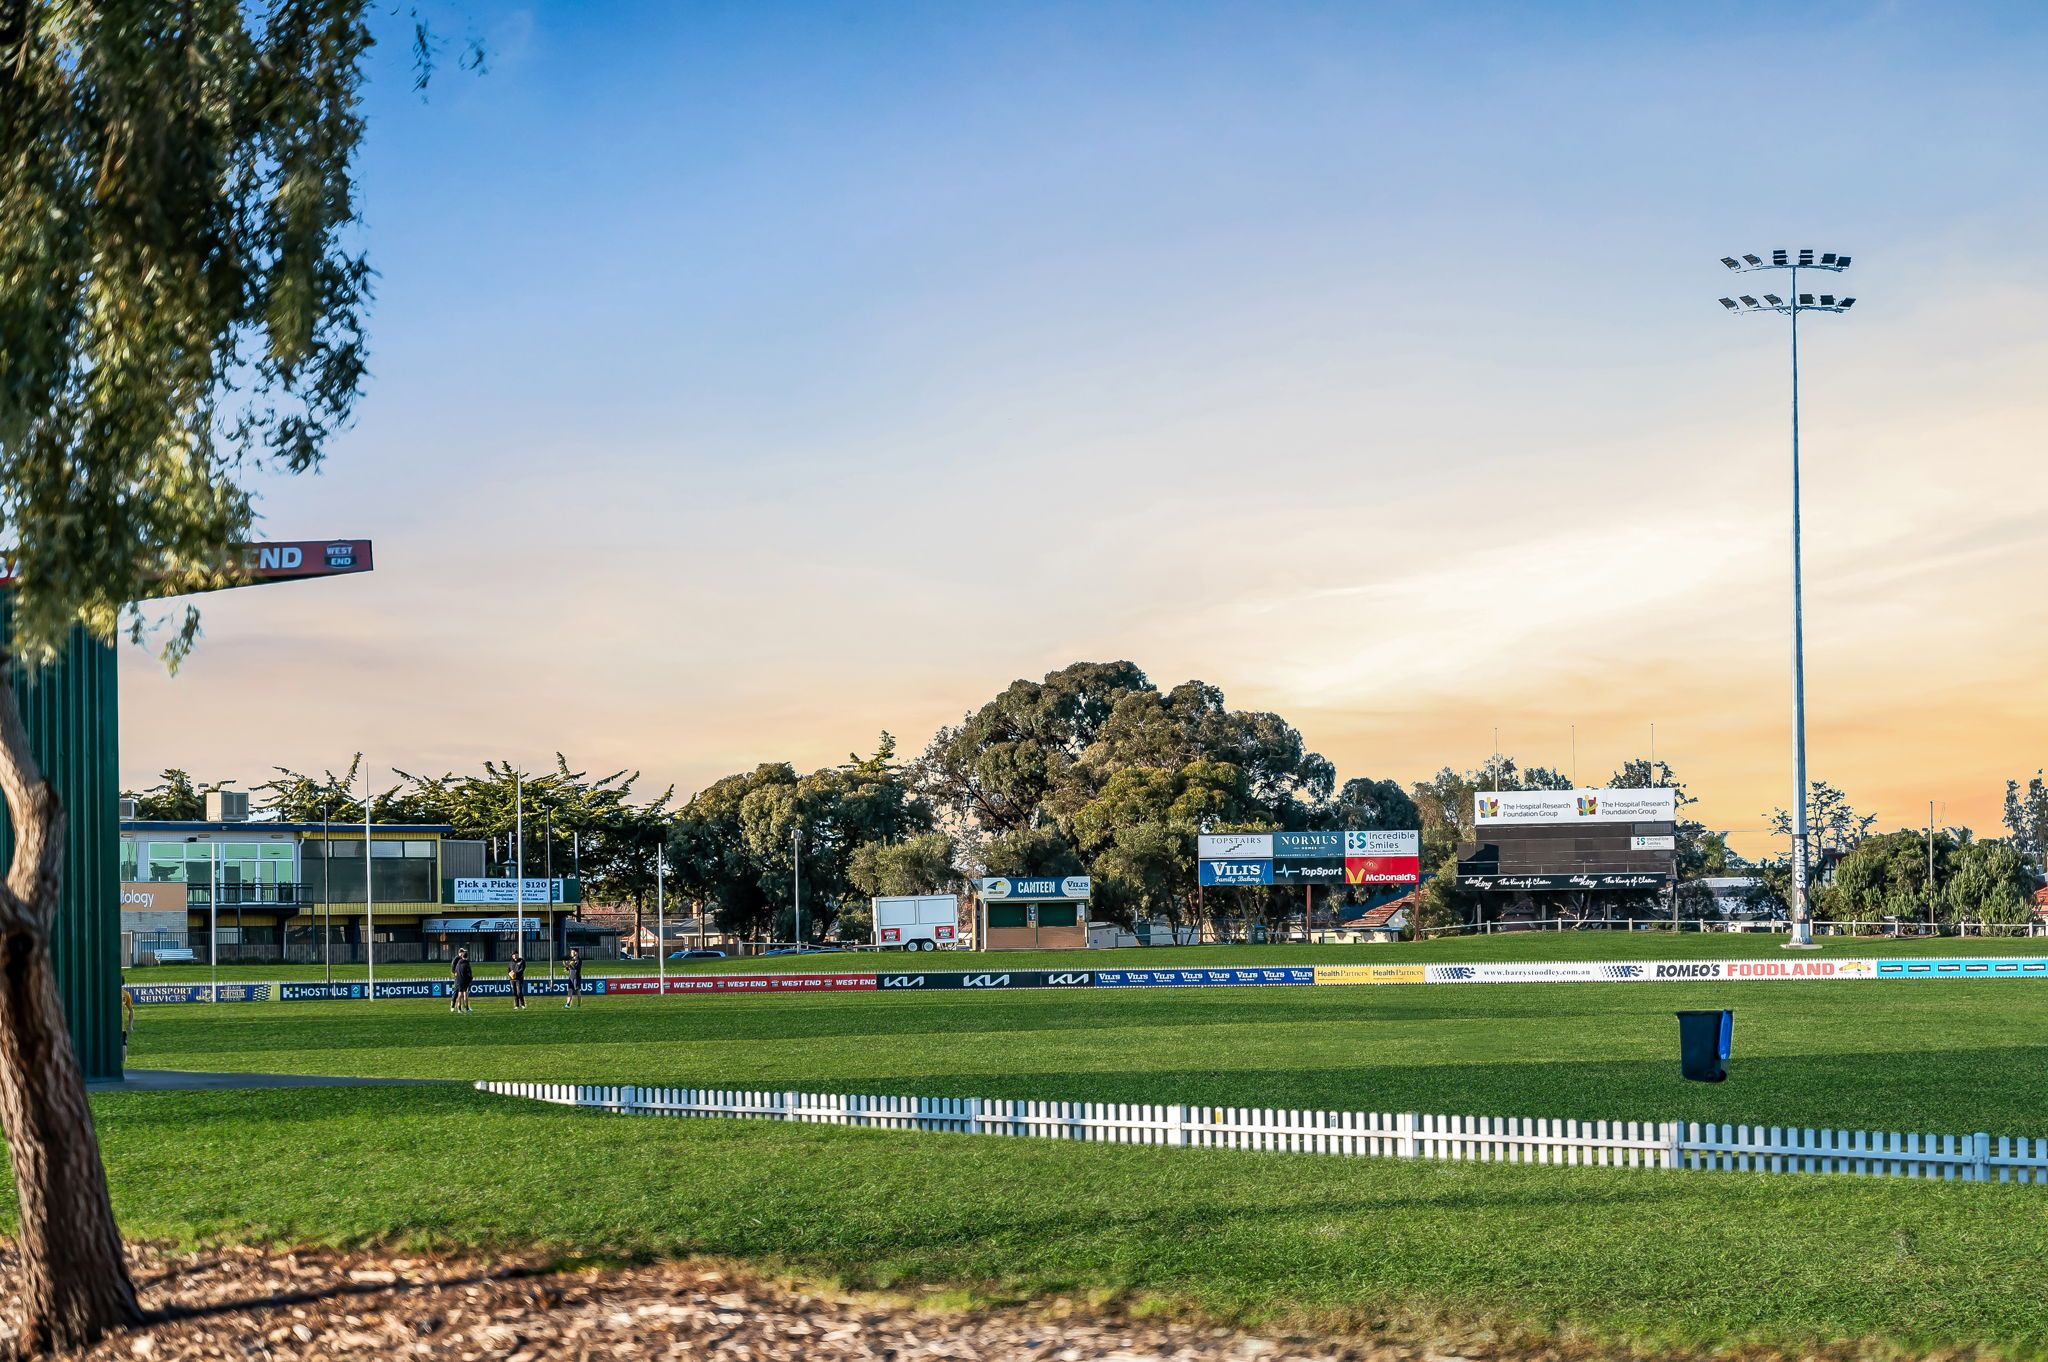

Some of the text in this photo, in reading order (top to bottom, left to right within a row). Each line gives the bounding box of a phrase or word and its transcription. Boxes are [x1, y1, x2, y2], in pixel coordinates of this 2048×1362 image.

[327, 546, 353, 555] WEST
[331, 557, 351, 566] END
[1516, 802, 1541, 811] Hospital
[1614, 801, 1640, 809] Hospital
[1539, 810, 1558, 818] Group
[1602, 808, 1657, 816] Foundation Group
[1281, 836, 1338, 845] NORMUS
[1369, 832, 1416, 840] Incredible
[1370, 841, 1399, 849] Smiles
[1300, 867, 1342, 877] TopSport
[1365, 873, 1416, 881] McDonald's
[1615, 876, 1630, 886] King
[1631, 875, 1638, 886] of
[457, 880, 479, 888] Pick
[491, 880, 520, 888] Picke
[526, 880, 547, 888] $120
[1511, 878, 1525, 888] King
[1526, 877, 1533, 888] of
[1533, 877, 1551, 885] Clean
[1018, 881, 1055, 894] CANTEEN
[1656, 963, 1835, 977] ROMEO'S FOODLAND
[134, 987, 193, 996] TRANSPORT
[381, 985, 429, 995] HOSTPLUS
[468, 984, 511, 993] OSTPLUS
[545, 983, 593, 992] HOSTUS
[140, 995, 187, 1003] SERVICES
